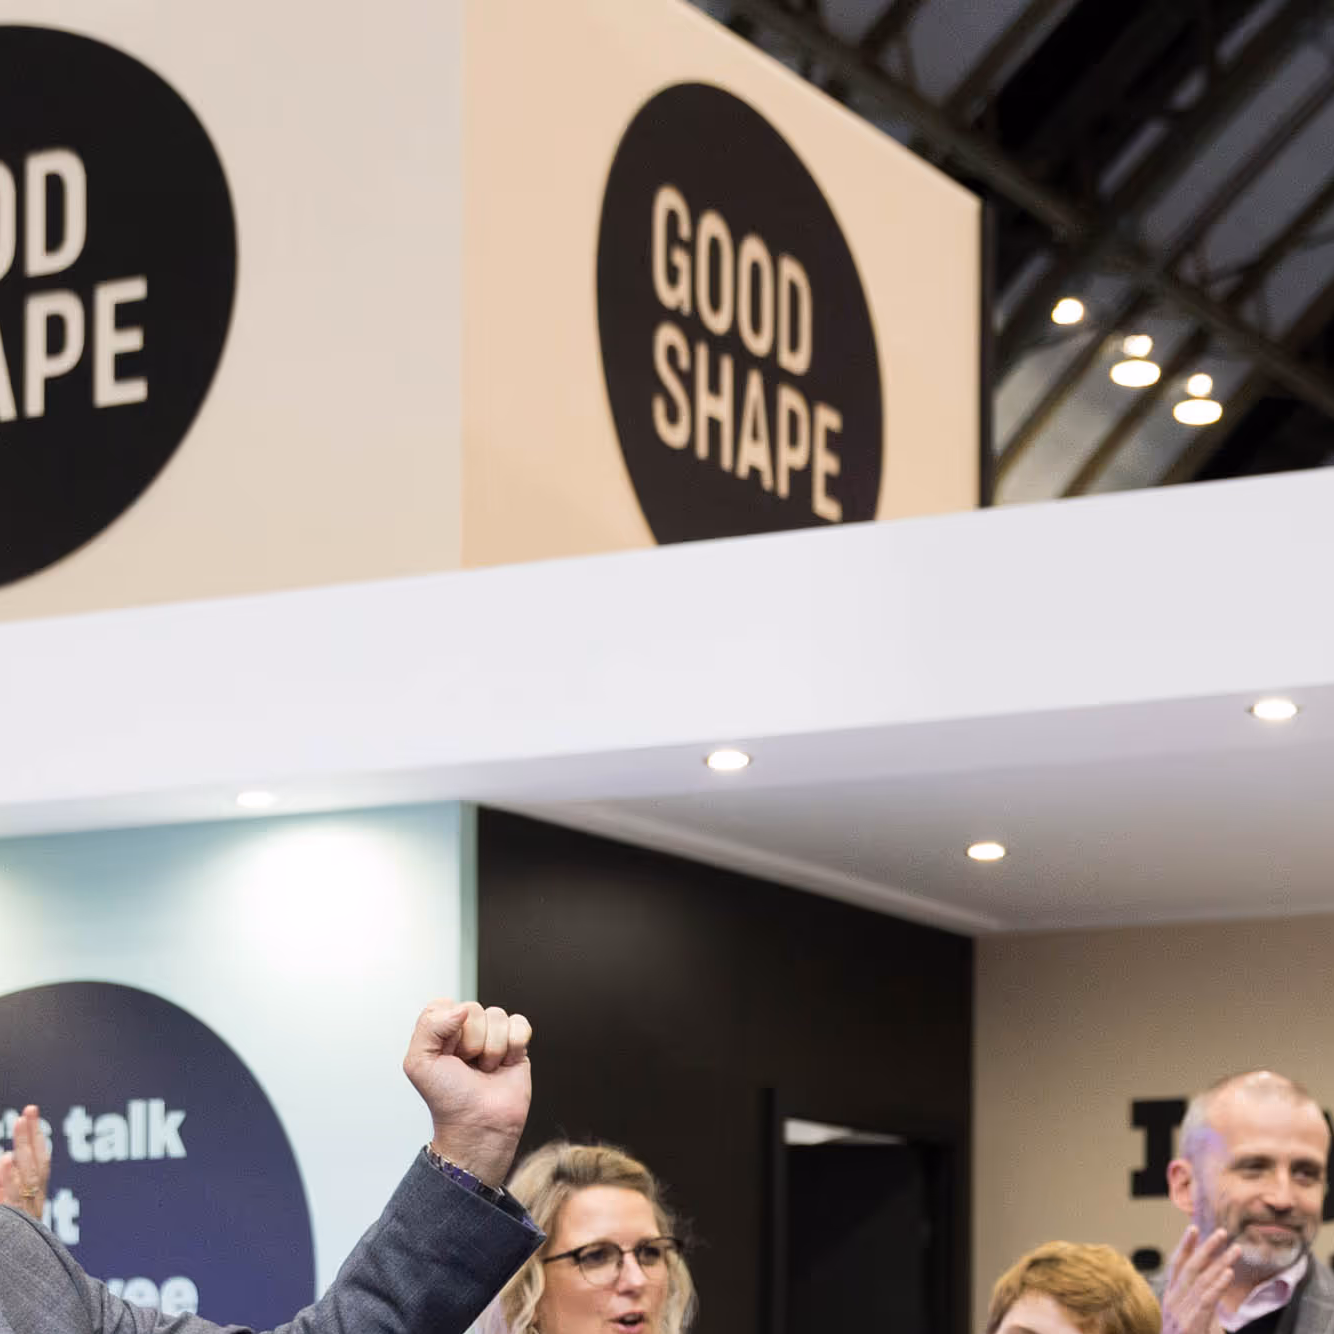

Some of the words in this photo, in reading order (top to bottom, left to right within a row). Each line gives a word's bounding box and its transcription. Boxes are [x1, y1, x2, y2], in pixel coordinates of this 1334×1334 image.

[651, 184, 813, 376] GOOD
[651, 322, 843, 523] SHAPE
[63, 1099, 188, 1163] talk
[1131, 1098, 1191, 1198] I
